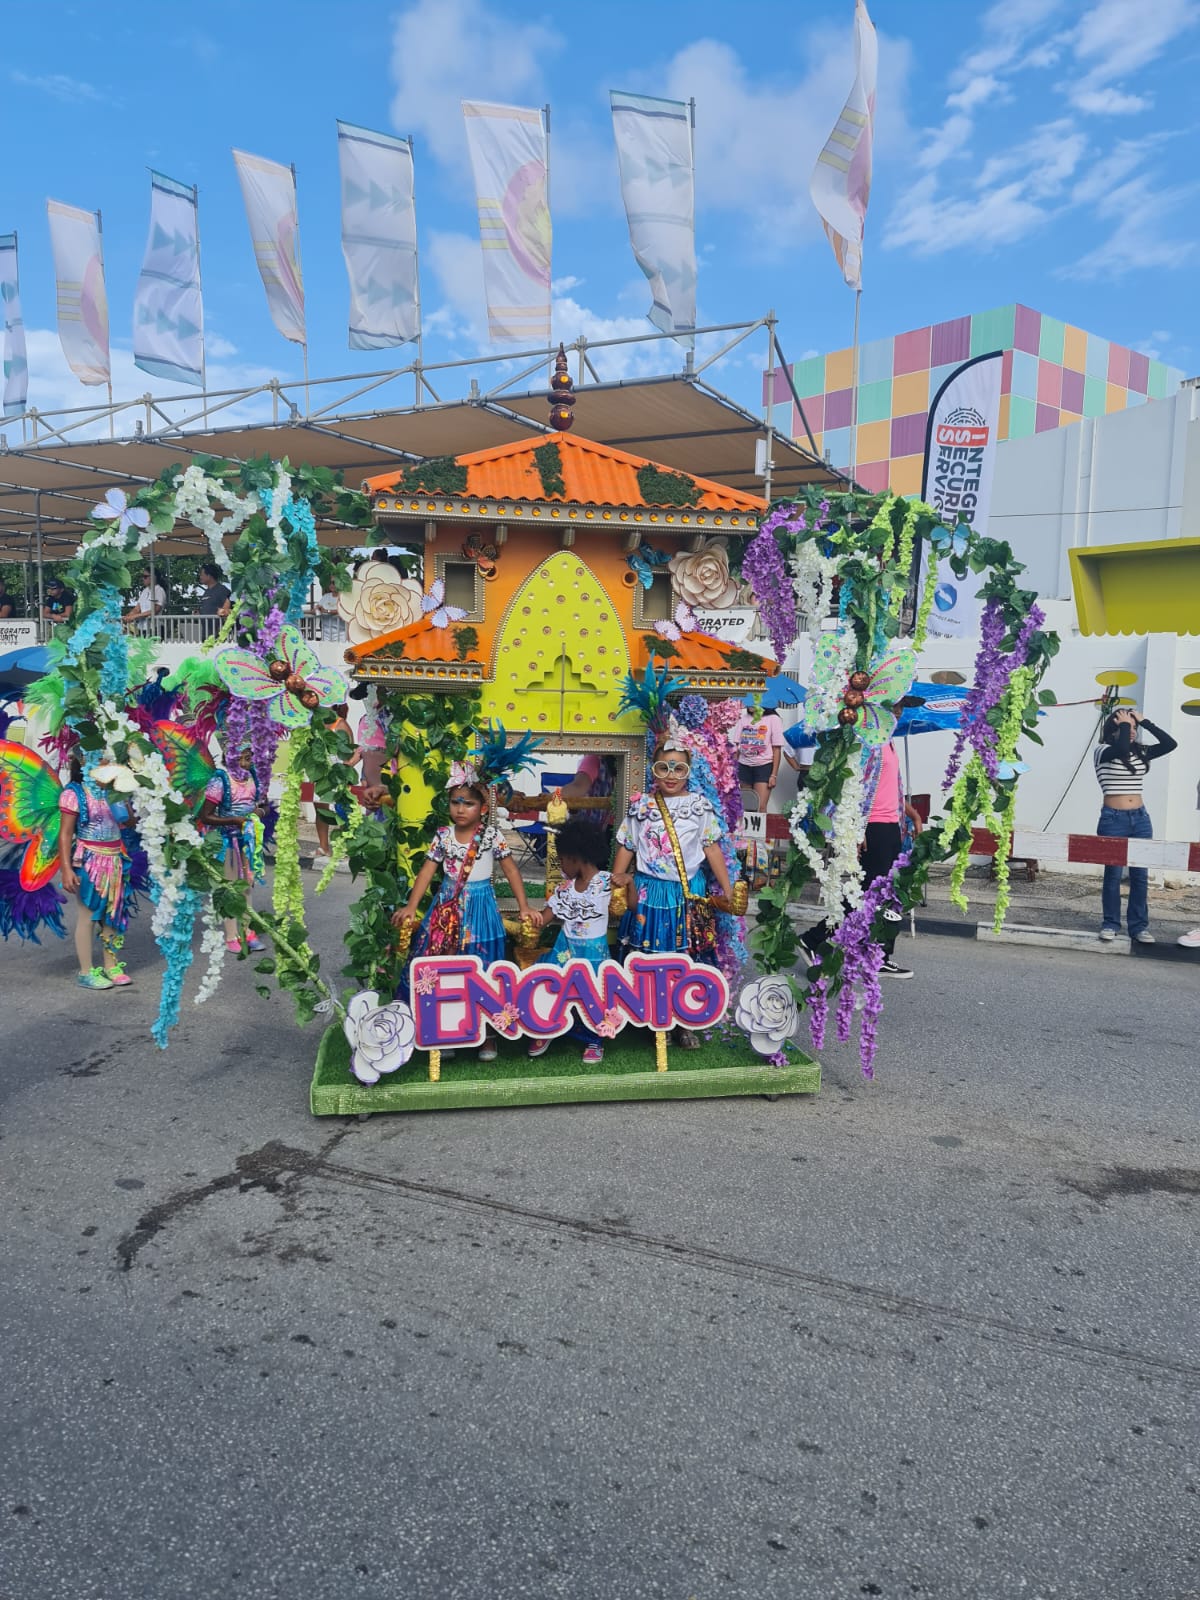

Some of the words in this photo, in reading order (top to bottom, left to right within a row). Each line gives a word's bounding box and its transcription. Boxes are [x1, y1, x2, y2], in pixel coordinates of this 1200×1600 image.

[942, 429, 970, 525] SECURIT
[698, 617, 745, 626] GRATED
[416, 956, 725, 1047] ENCANTO
